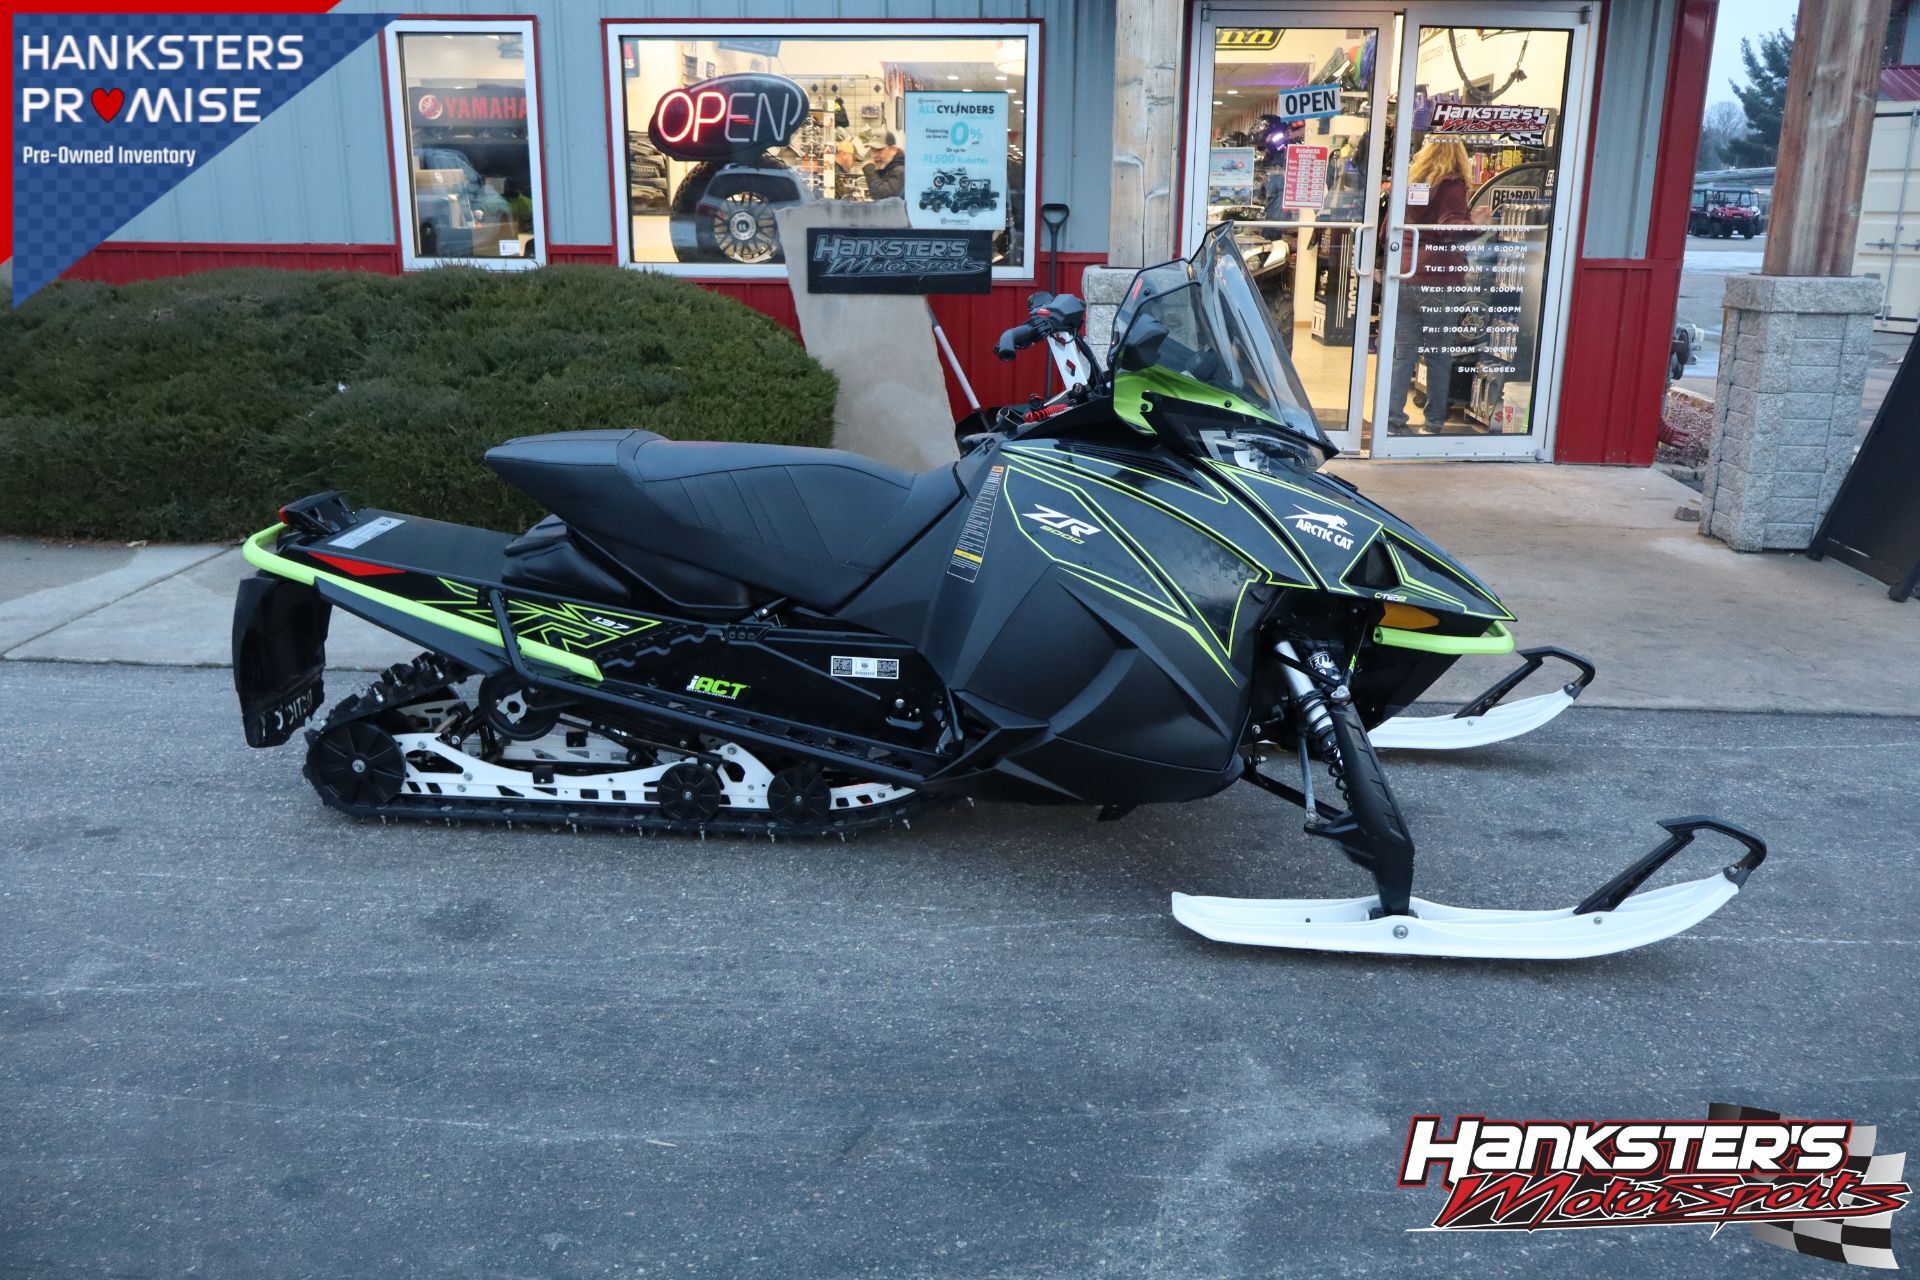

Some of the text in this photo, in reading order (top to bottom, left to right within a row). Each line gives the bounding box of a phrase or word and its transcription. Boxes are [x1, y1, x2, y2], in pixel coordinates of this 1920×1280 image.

[445, 96, 527, 119] YAMAHA
[1285, 89, 1336, 115] OPEN
[657, 90, 789, 143] OPEN
[1450, 244, 1485, 252] 9:00AM
[1491, 265, 1526, 273] 6:00PM
[1446, 285, 1481, 293] 9:00AM
[1021, 503, 1102, 538] ZR
[1295, 518, 1355, 551] ARCTIC CAT
[686, 675, 748, 699] iACT
